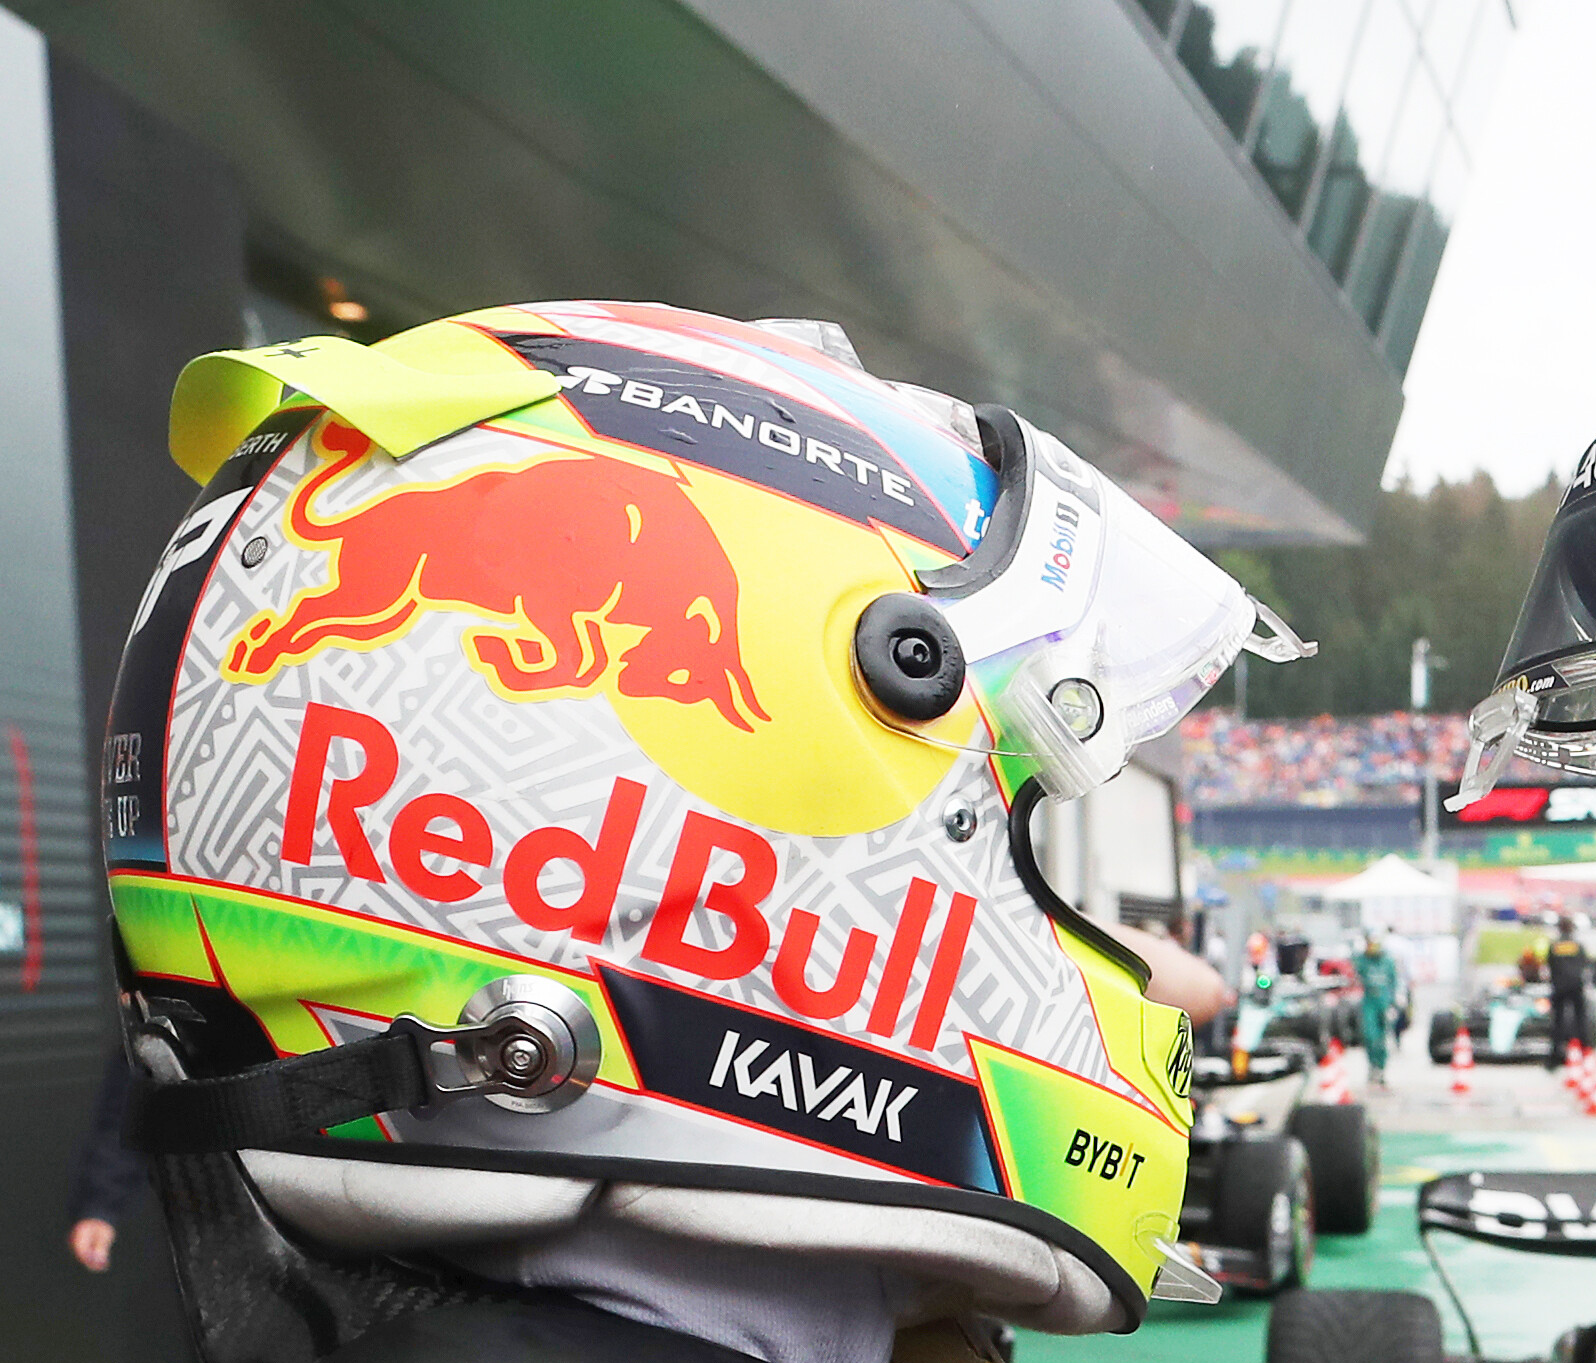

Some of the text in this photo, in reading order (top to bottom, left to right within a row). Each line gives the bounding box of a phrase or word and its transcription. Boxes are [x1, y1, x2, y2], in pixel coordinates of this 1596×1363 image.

[619, 381, 916, 506] BANORTE
[281, 702, 978, 1052] Red Bull
[708, 1029, 918, 1142] KAVAK
[1065, 1129, 1145, 1189] BYBIT
